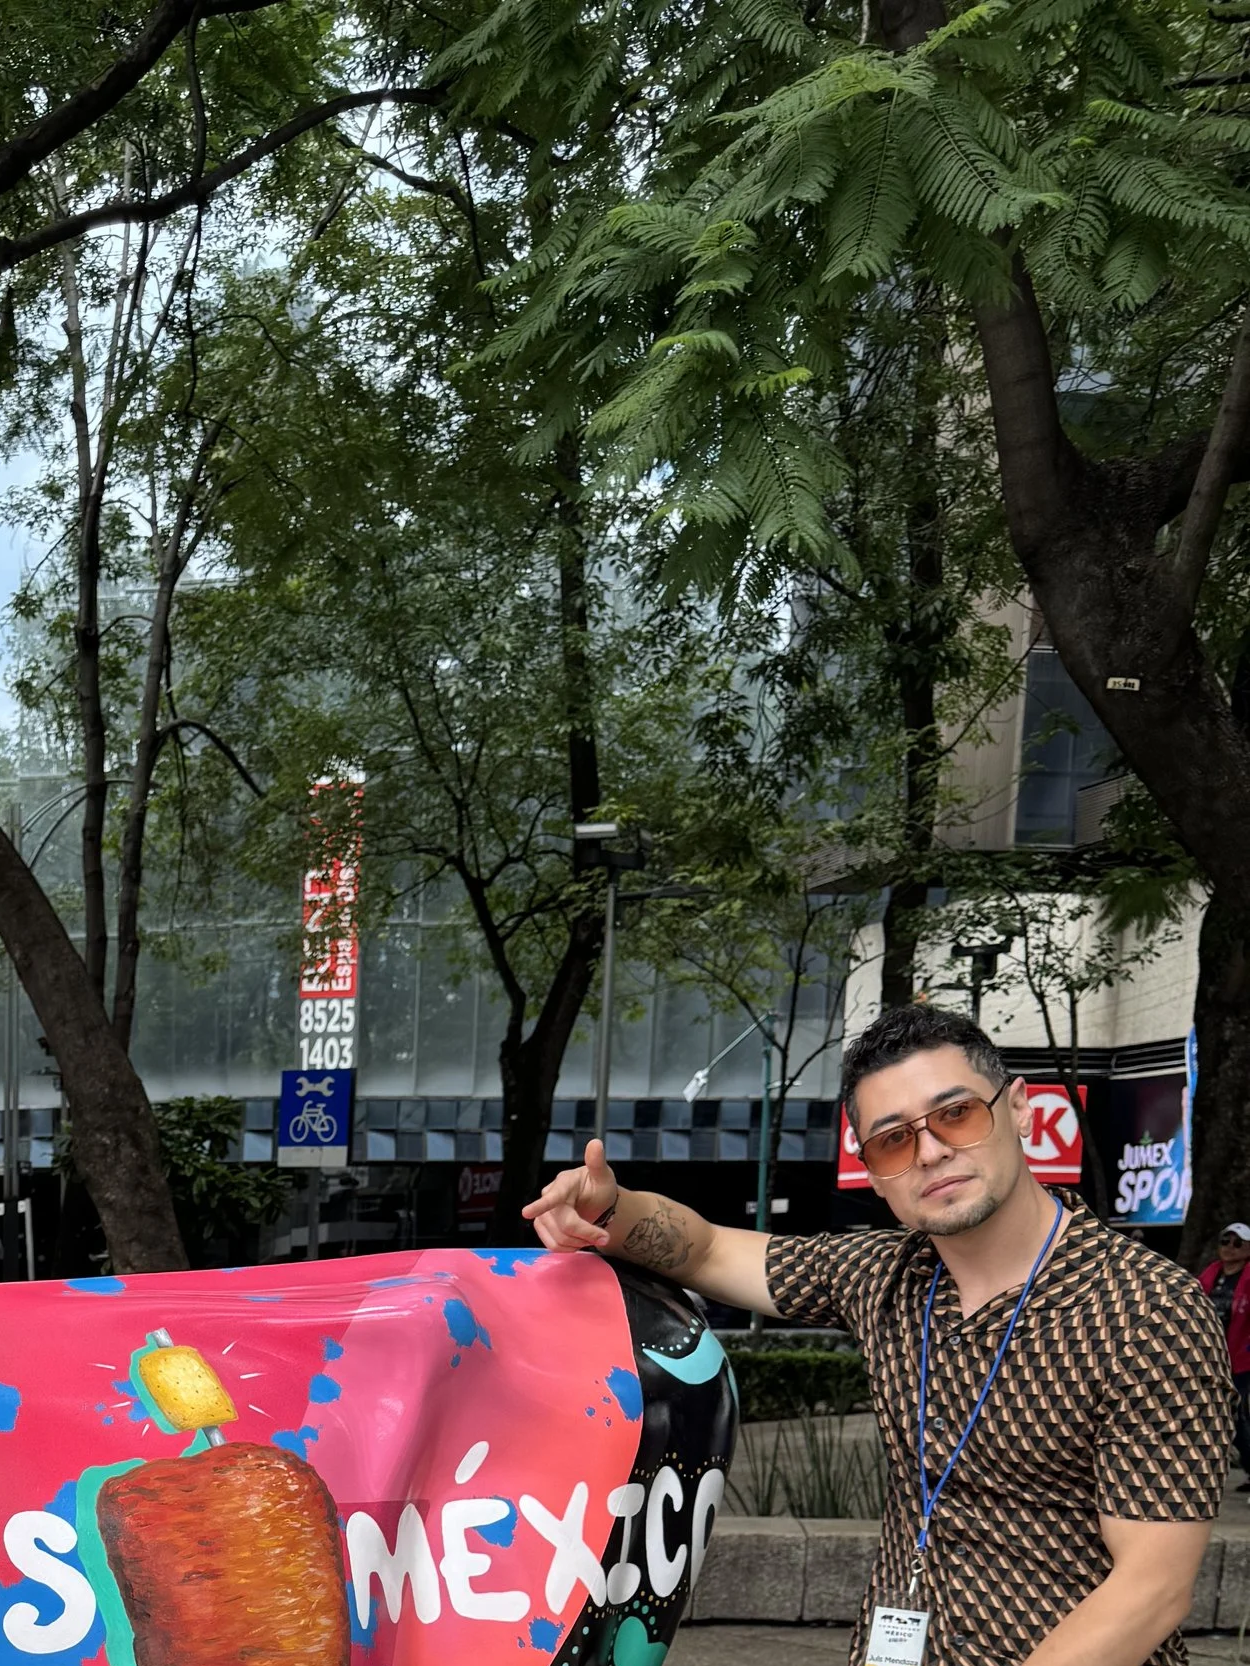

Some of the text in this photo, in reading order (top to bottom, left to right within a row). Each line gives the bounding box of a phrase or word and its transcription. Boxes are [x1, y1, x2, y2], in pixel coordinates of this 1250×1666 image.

[299, 998, 356, 1033] 8525
[299, 1037, 354, 1071] 1403
[1031, 1107, 1071, 1149] K
[1117, 1138, 1176, 1170] JUMEX
[346, 1440, 725, 1630] MÉXICO
